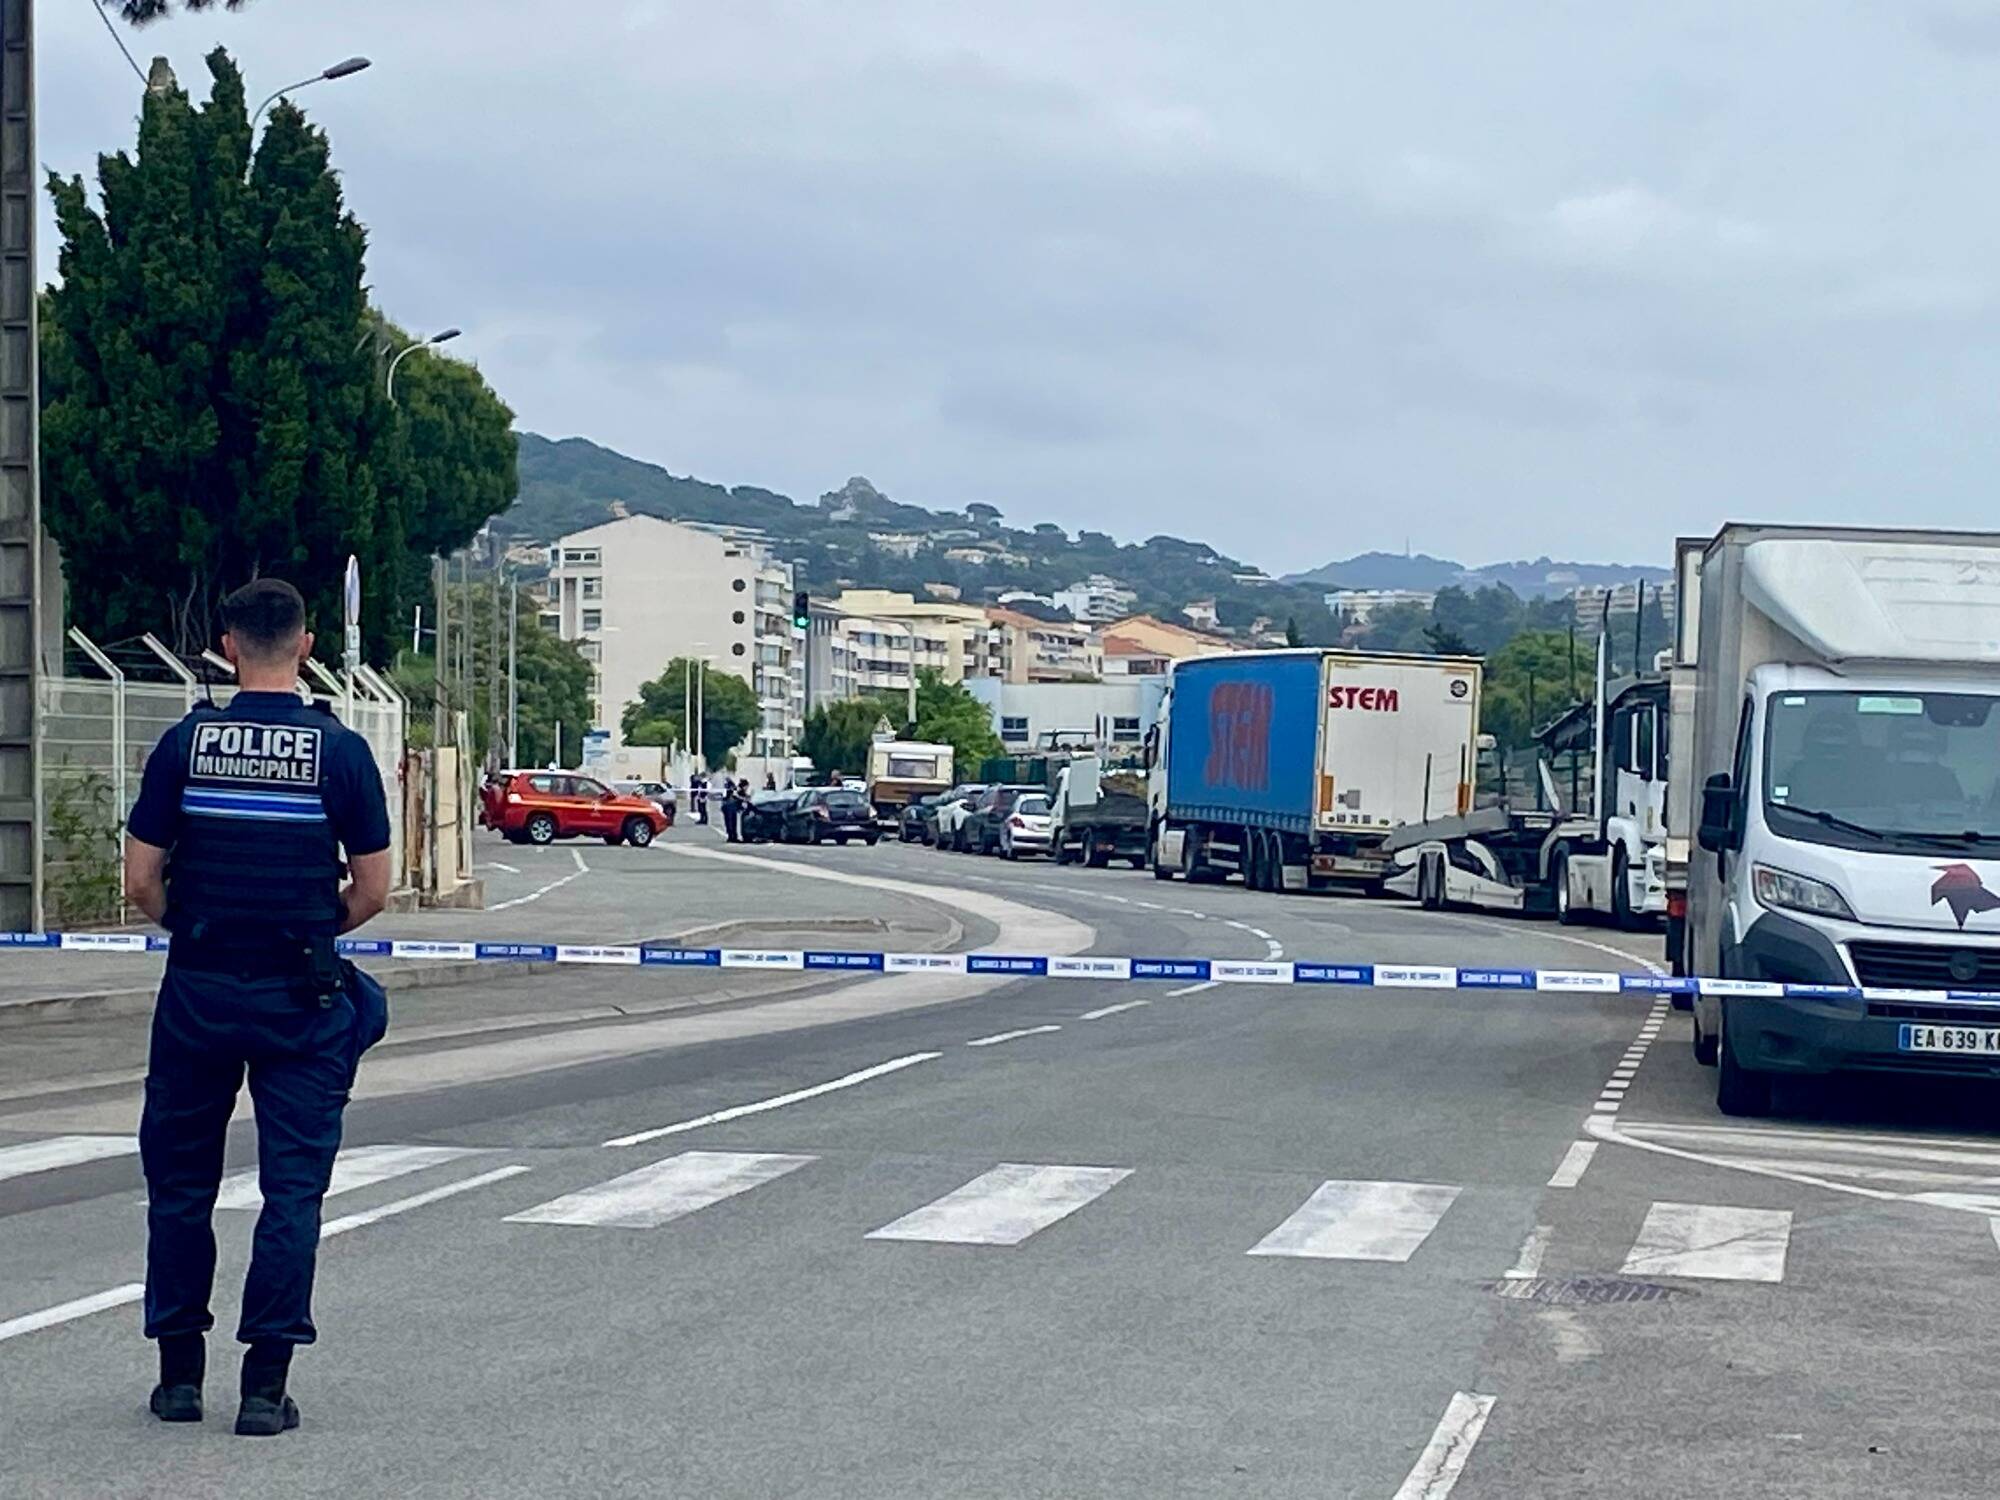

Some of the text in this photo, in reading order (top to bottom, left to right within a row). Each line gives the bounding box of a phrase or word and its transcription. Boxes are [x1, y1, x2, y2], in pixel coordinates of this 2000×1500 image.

[1329, 686, 1399, 712] STEM
[199, 726, 314, 760] POLICE
[196, 755, 313, 780] MUNICIPALE
